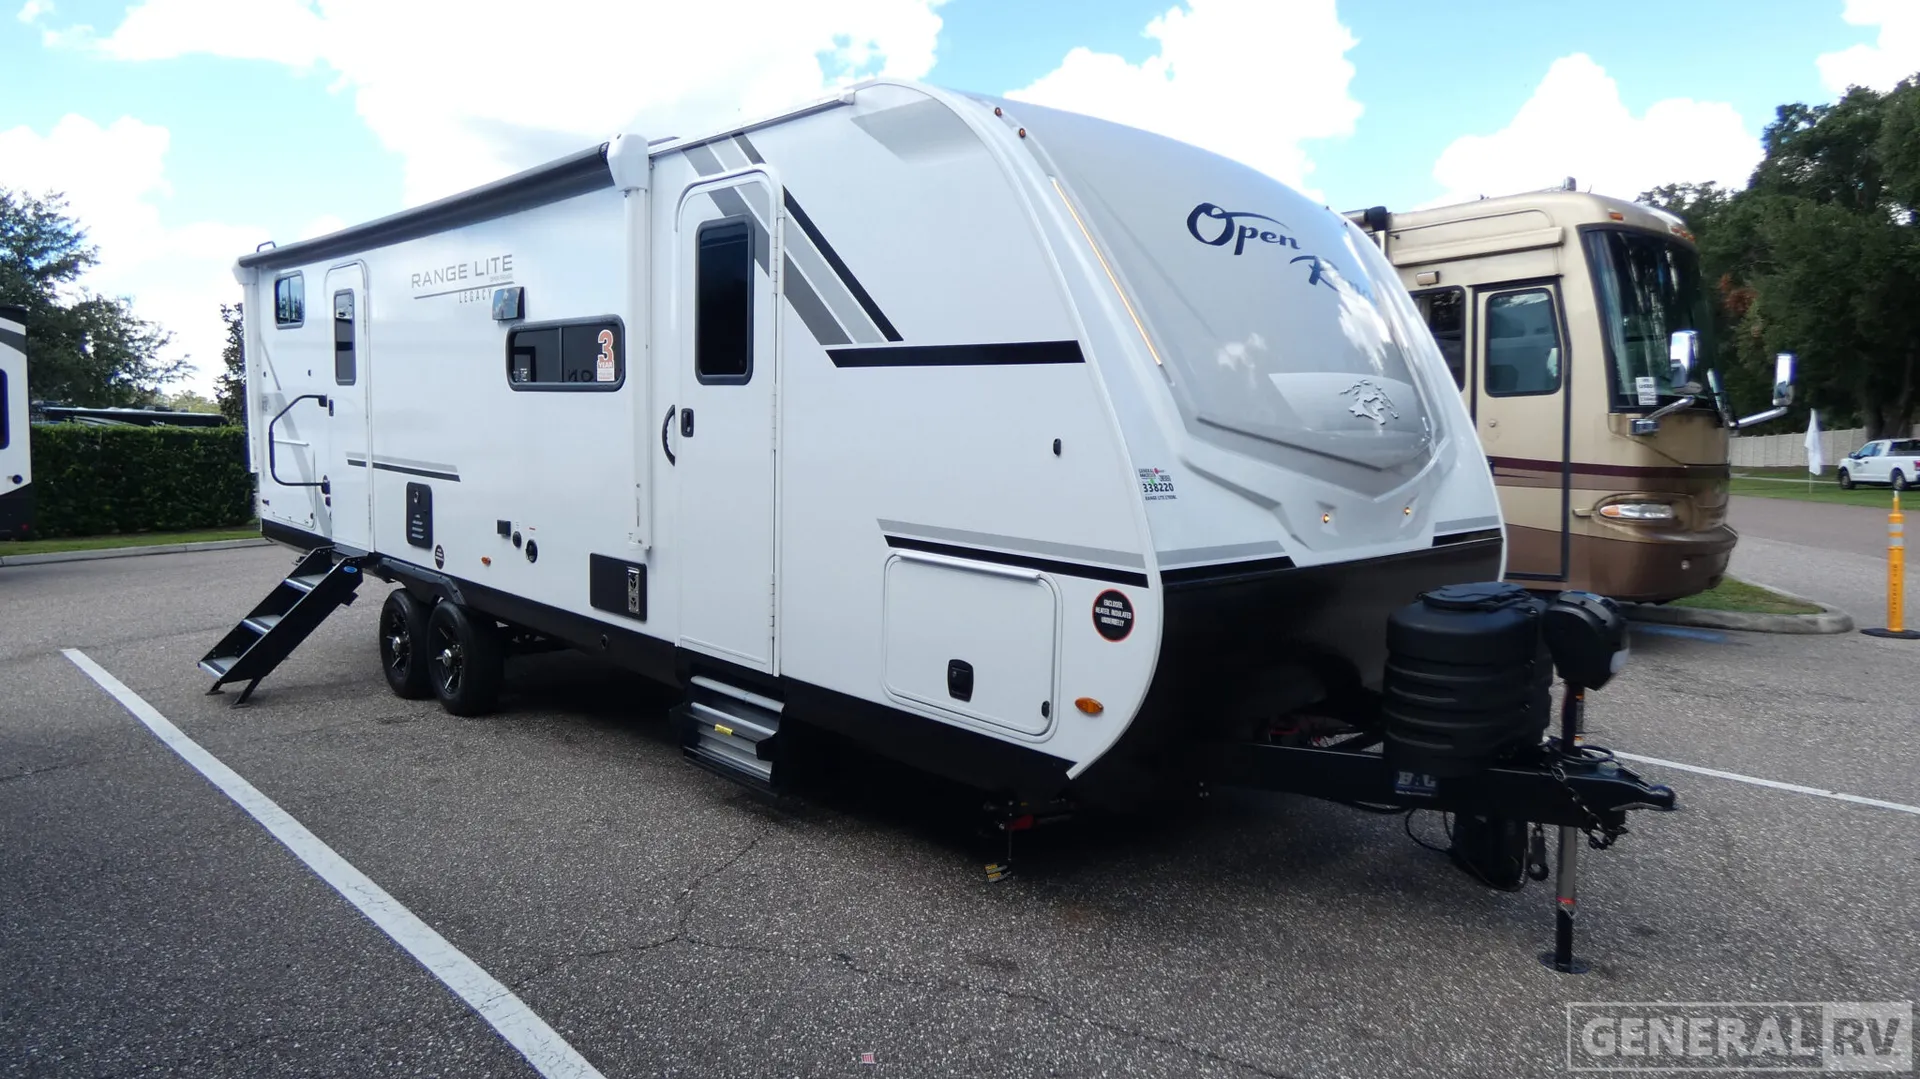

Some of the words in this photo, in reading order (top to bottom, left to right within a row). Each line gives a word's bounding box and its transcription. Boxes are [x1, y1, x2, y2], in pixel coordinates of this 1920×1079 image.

[1187, 203, 1300, 255] Open
[411, 263, 467, 288] RANGE
[475, 254, 513, 277] LITE
[459, 288, 492, 304] LEGACY
[597, 329, 614, 363] 3
[598, 361, 614, 369] YEAR
[1142, 482, 1175, 493] 338220
[1110, 609, 1132, 619] INSULATED
